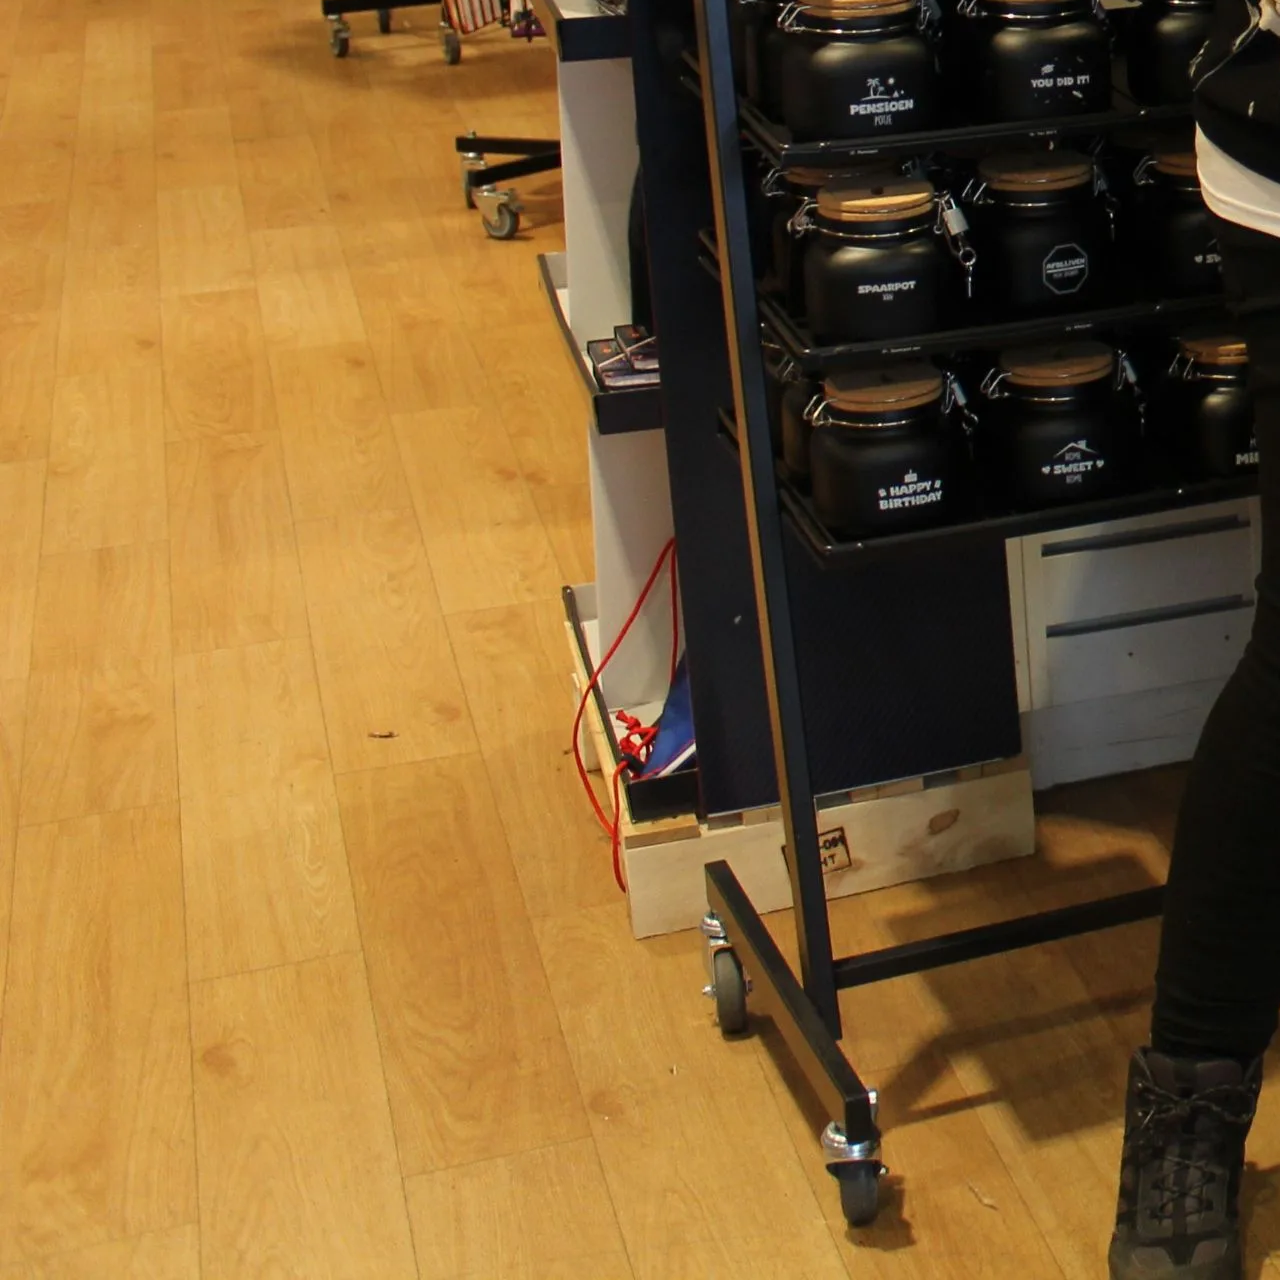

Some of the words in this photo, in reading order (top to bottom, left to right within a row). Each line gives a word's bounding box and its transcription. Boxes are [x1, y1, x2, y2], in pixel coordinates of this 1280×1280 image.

[1031, 78, 1053, 88] YOU
[1057, 77, 1074, 87] DID
[857, 280, 917, 295] SPAARPOT
[1053, 460, 1093, 475] SWEET
[889, 479, 932, 497] HAPPY
